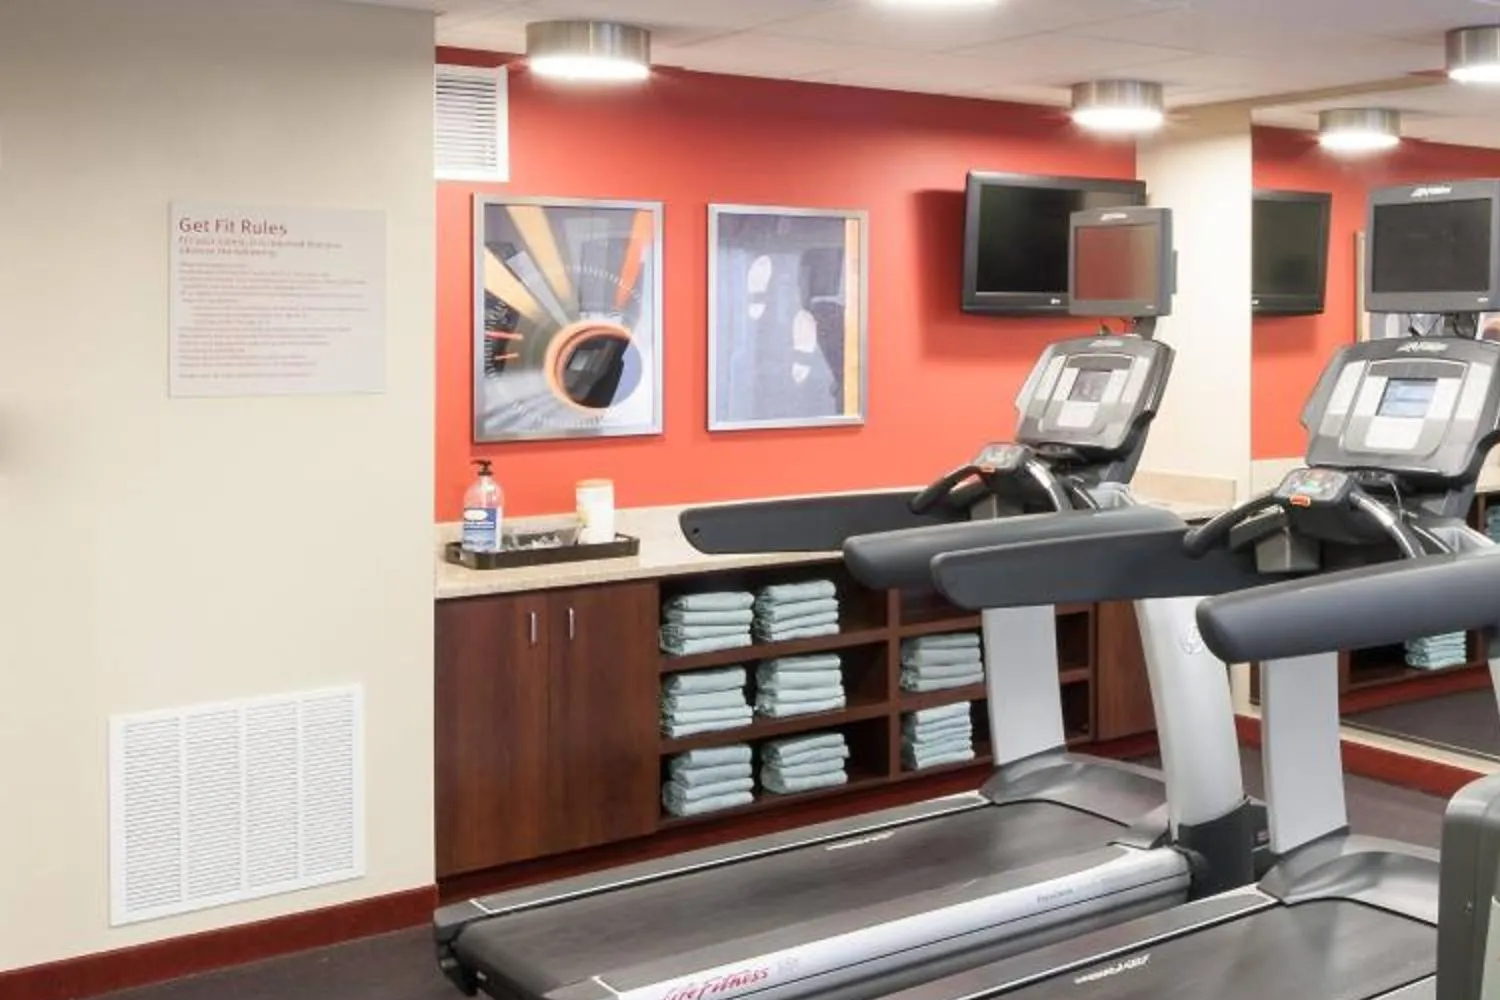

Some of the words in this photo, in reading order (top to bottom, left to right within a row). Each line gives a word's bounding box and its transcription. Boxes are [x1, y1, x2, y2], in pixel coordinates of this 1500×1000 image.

[179, 217, 209, 233] Get
[215, 218, 235, 233] Fit
[241, 218, 288, 235] Rules
